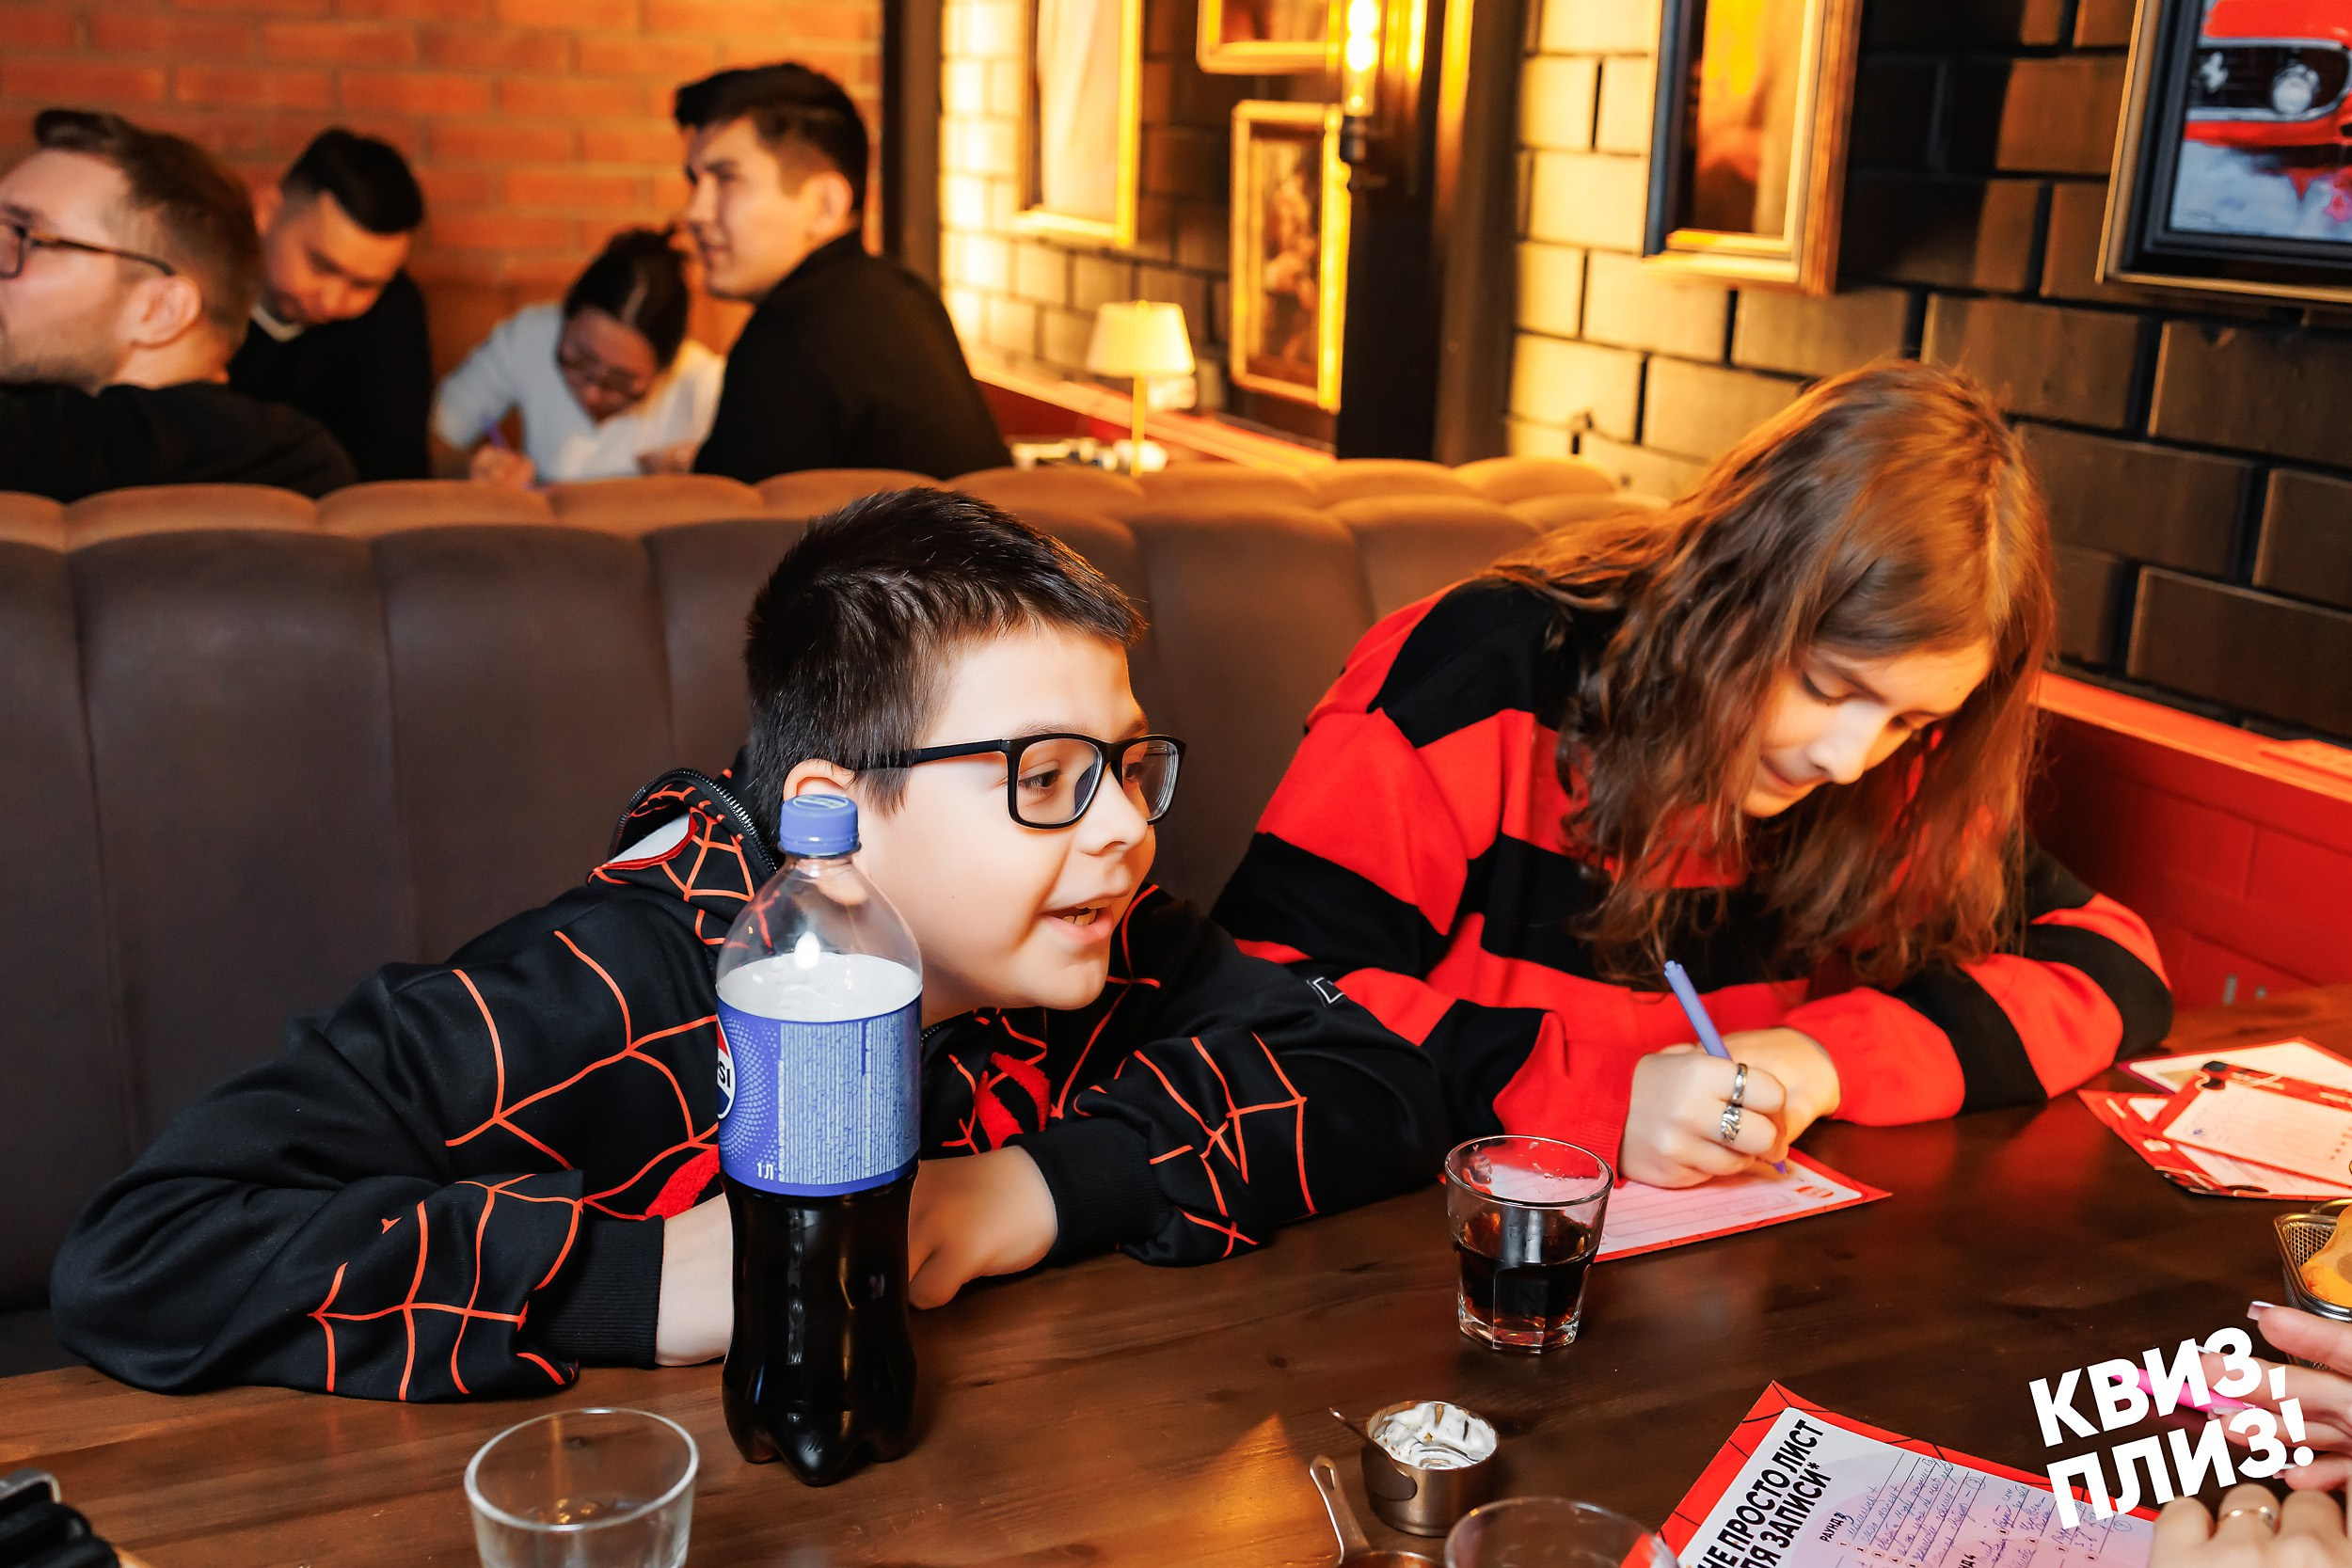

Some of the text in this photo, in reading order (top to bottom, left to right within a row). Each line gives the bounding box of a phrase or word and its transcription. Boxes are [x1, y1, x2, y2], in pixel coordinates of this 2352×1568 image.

[1716, 1468, 1791, 1552] ПРОСТО
[1771, 1418, 1823, 1474] ЛИСТ
[1820, 1517, 1844, 1543] РАУНД
